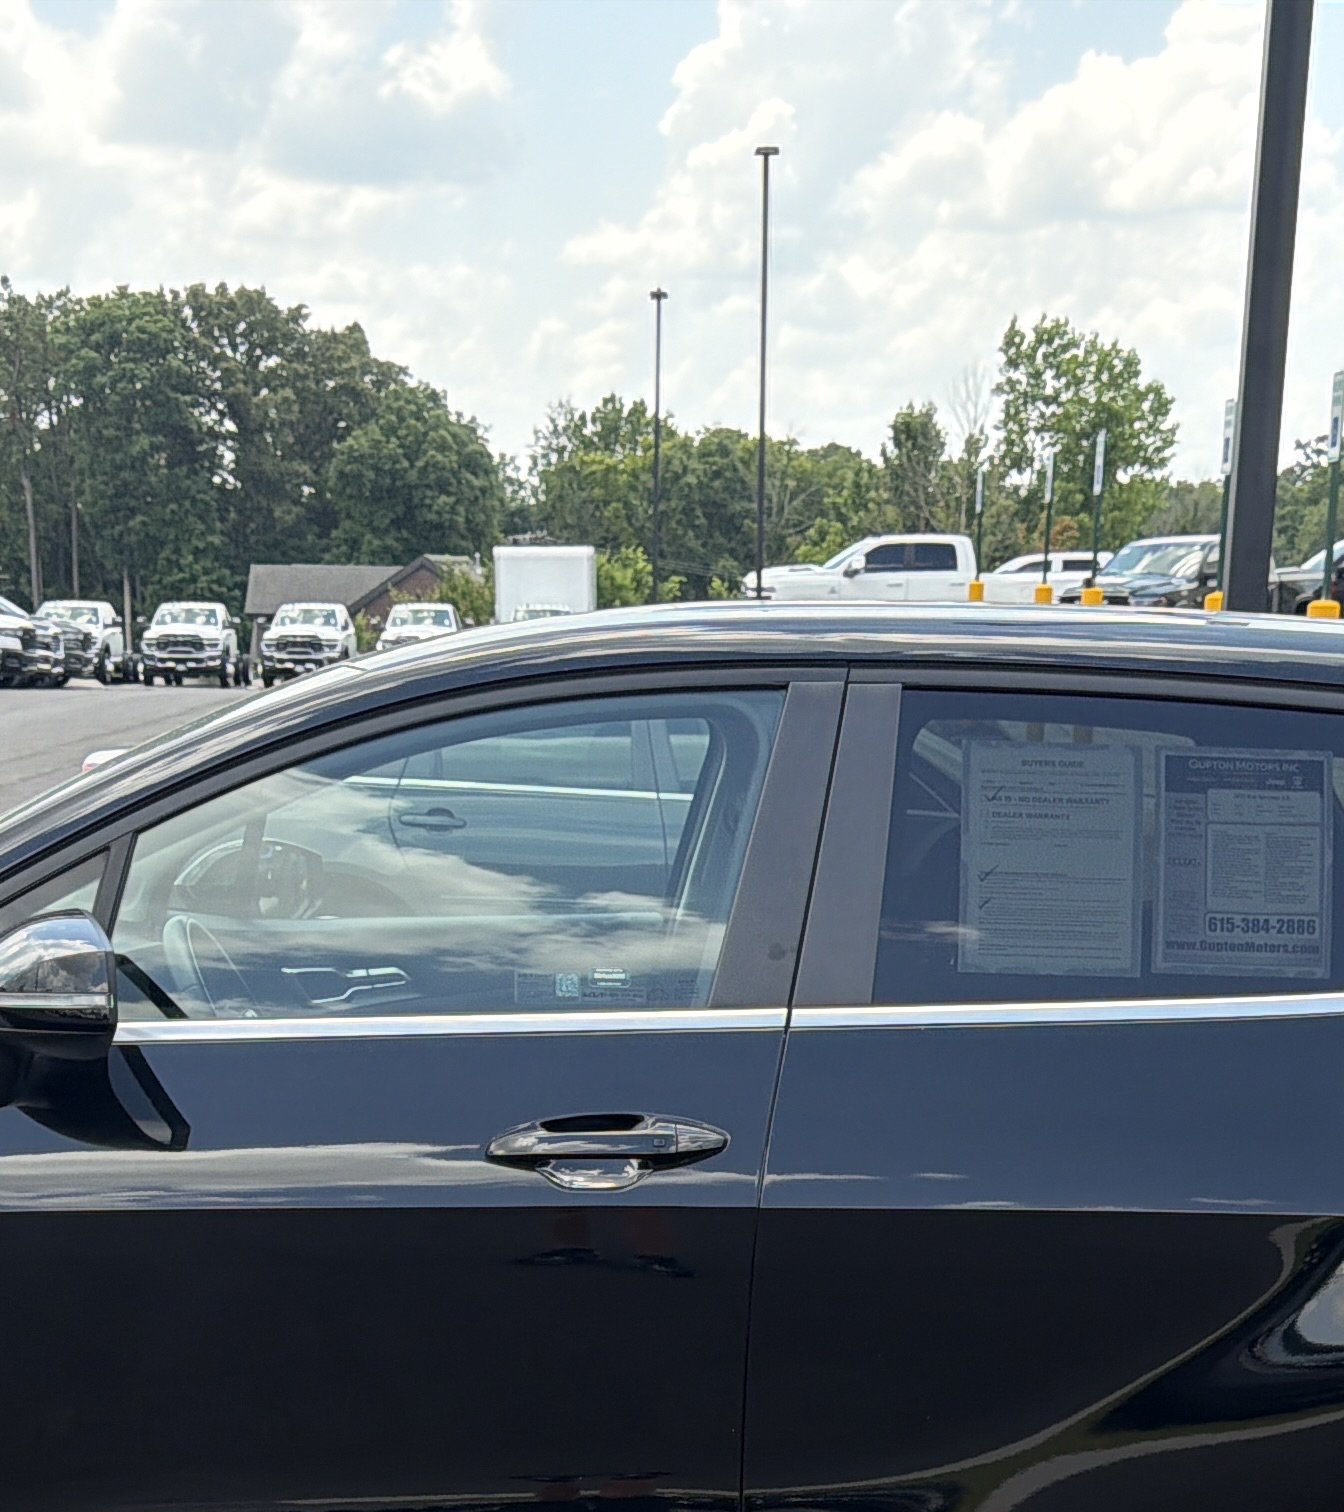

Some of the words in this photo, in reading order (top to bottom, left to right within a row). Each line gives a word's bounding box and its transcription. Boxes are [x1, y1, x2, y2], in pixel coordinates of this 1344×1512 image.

[1188, 758, 1234, 771] GUPTON
[1235, 760, 1280, 773] MOTORS
[1031, 796, 1064, 805] DEALER
[1065, 797, 1110, 805] WARRANTY
[1207, 915, 1317, 935] 615-384-2886
[1166, 938, 1320, 955] www.GuptonMotors.com
